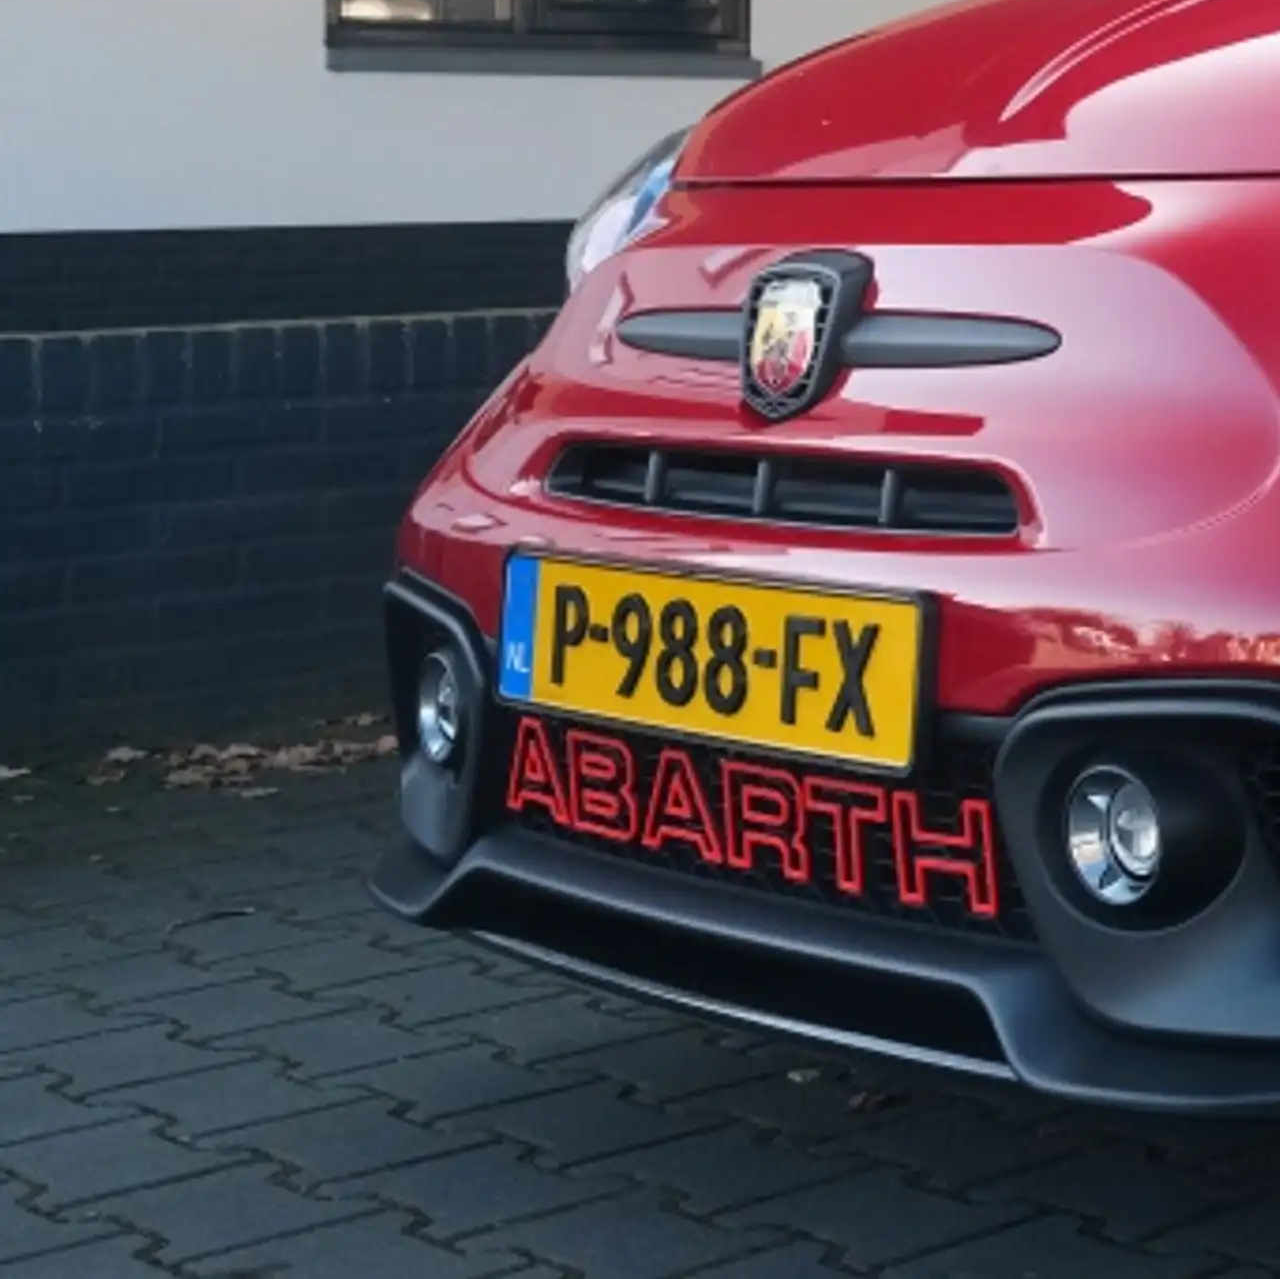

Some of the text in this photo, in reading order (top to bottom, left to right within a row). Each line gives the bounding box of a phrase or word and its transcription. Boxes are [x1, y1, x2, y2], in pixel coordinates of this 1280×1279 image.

[505, 641, 530, 673] NL
[551, 585, 880, 738] P-988-FX
[506, 715, 998, 917] ABARTH
